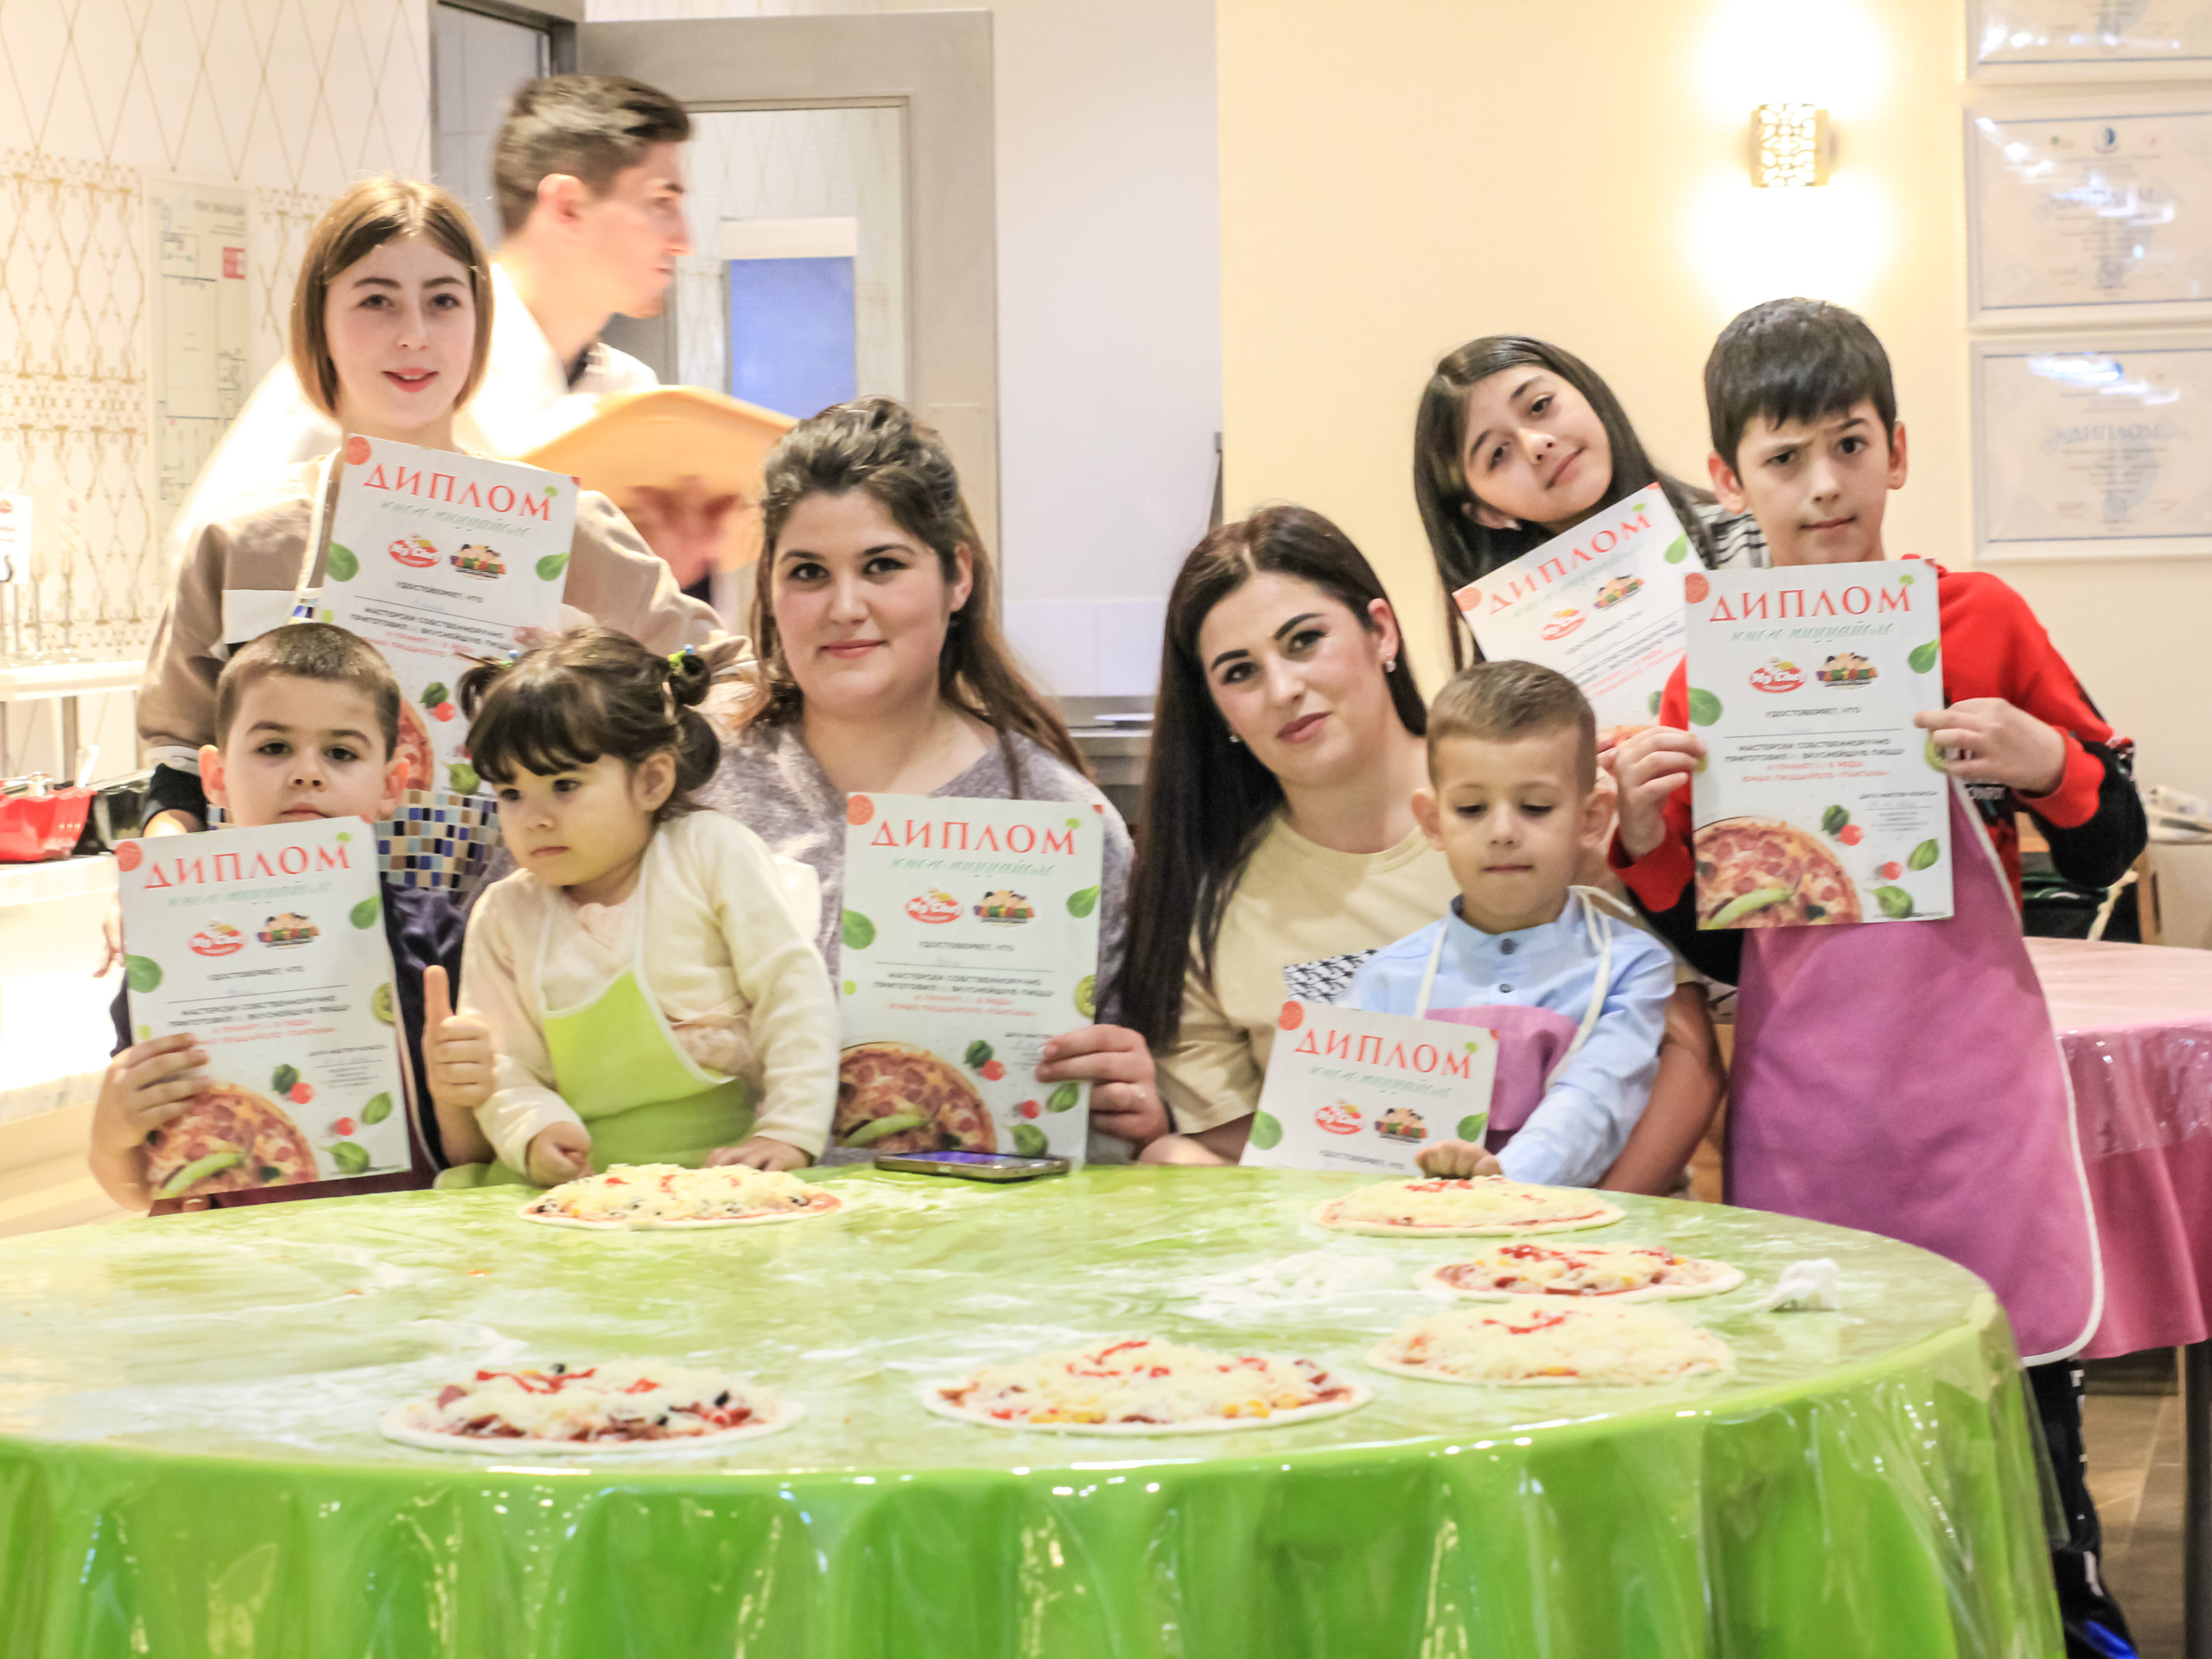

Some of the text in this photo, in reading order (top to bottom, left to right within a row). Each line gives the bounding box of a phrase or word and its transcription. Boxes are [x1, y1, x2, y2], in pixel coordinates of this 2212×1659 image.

[364, 462, 551, 522] ДИПЛОМ
[1488, 511, 1653, 615] ДИПЛОМ
[1708, 585, 1913, 623] ДИПЛОМ
[870, 819, 1075, 855] ДИПЛОМ
[143, 843, 352, 889] ДИПЛОМ
[1294, 1027, 1472, 1080] ДИПЛОМ
